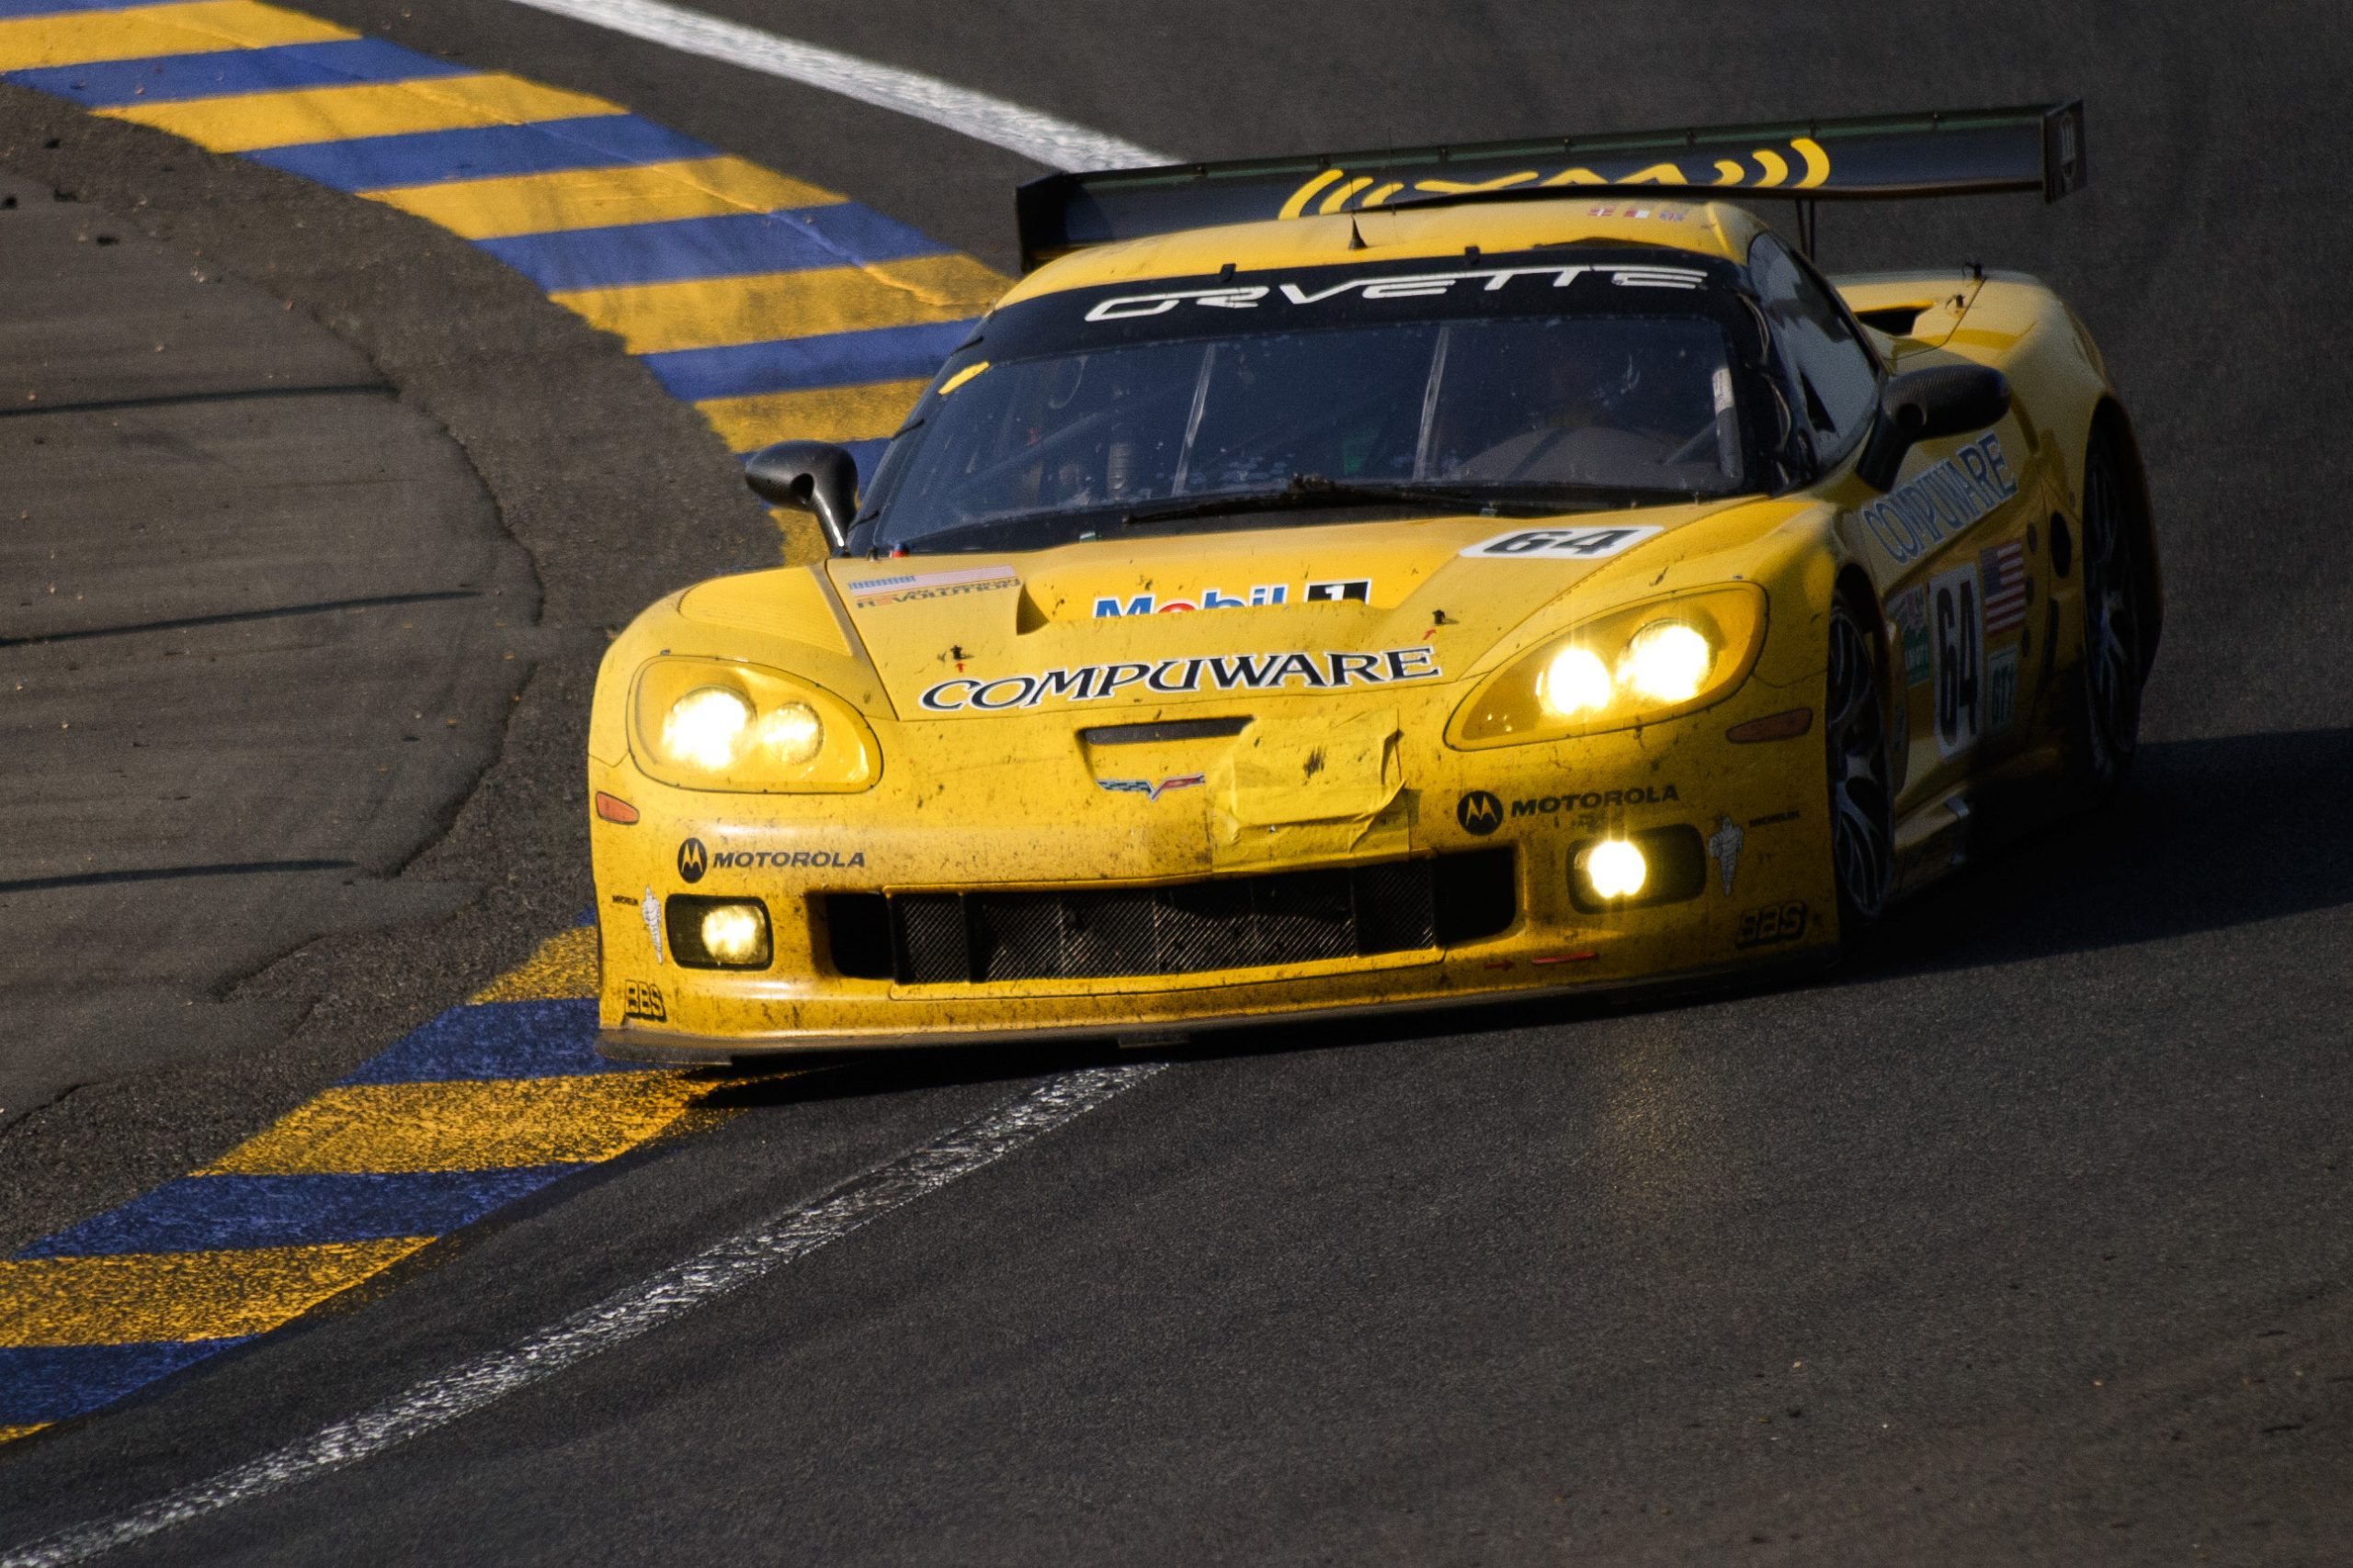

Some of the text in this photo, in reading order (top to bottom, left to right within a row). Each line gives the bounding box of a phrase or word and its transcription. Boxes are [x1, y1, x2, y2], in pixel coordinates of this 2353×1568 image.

[1483, 530, 1641, 555] 64
[920, 648, 1440, 710] COMPUWARE
[1936, 580, 1979, 746] 64
[1510, 785, 1679, 818] MOTOROLA
[712, 851, 866, 869] MOTOROLA
[625, 980, 667, 1022] BBS
